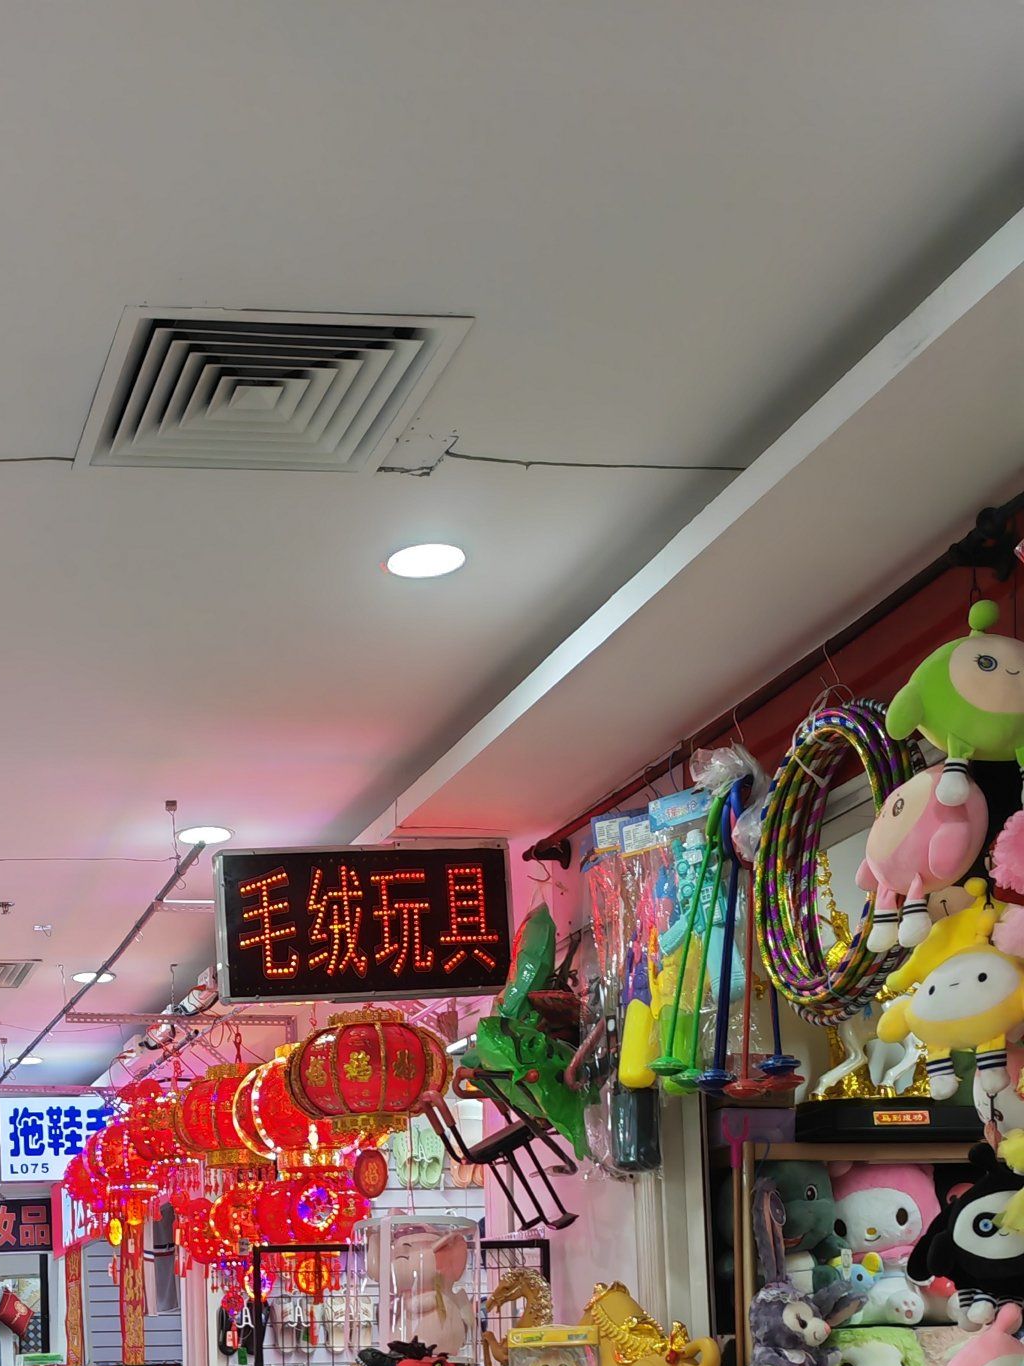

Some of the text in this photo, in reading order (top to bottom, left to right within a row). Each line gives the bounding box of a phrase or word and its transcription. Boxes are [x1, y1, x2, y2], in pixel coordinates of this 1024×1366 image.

[238, 863, 500, 980] 毛绒玩具
[882, 1114, 923, 1122] 马到成功
[10, 1163, 50, 1175] L075
